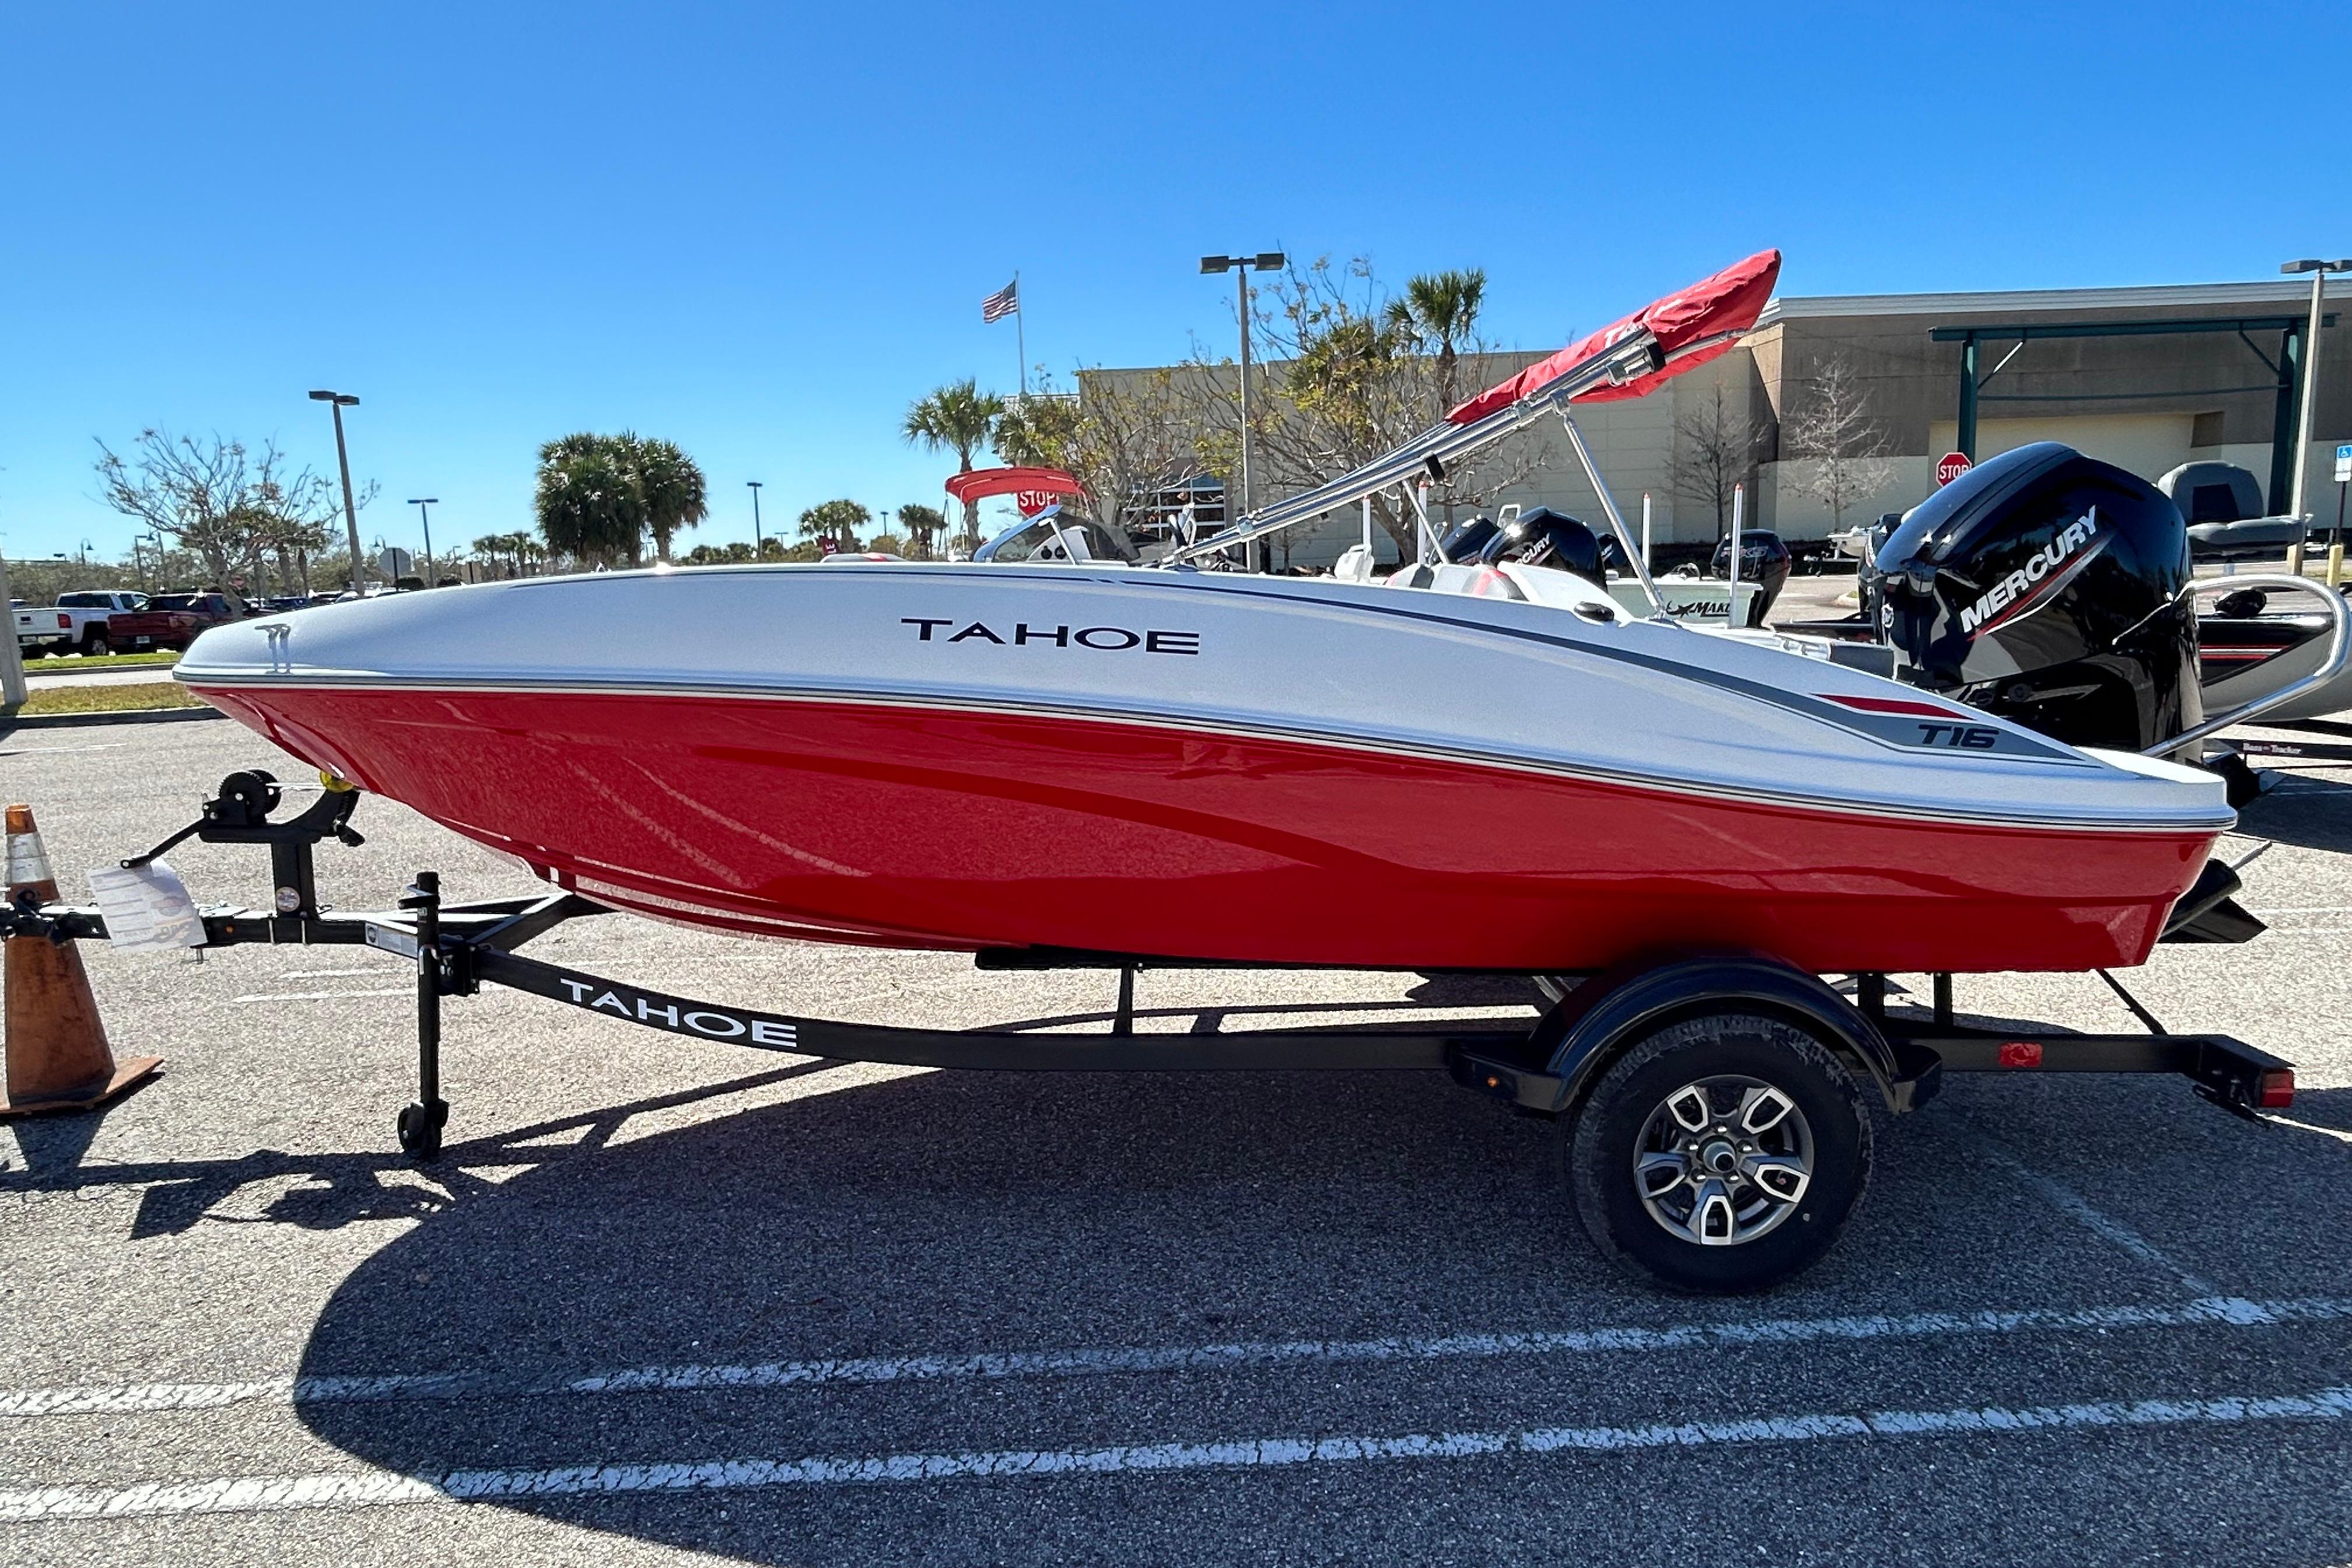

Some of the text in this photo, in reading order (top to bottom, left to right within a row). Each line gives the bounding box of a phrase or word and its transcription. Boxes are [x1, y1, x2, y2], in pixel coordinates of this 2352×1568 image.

[1939, 464, 1969, 479] STOP
[1020, 491, 1055, 507] STOP
[1960, 505, 2096, 633] MERCURY
[901, 618, 1199, 654] TAHOE
[1918, 724, 2000, 748] T16
[560, 978, 797, 1048] TAHOE
